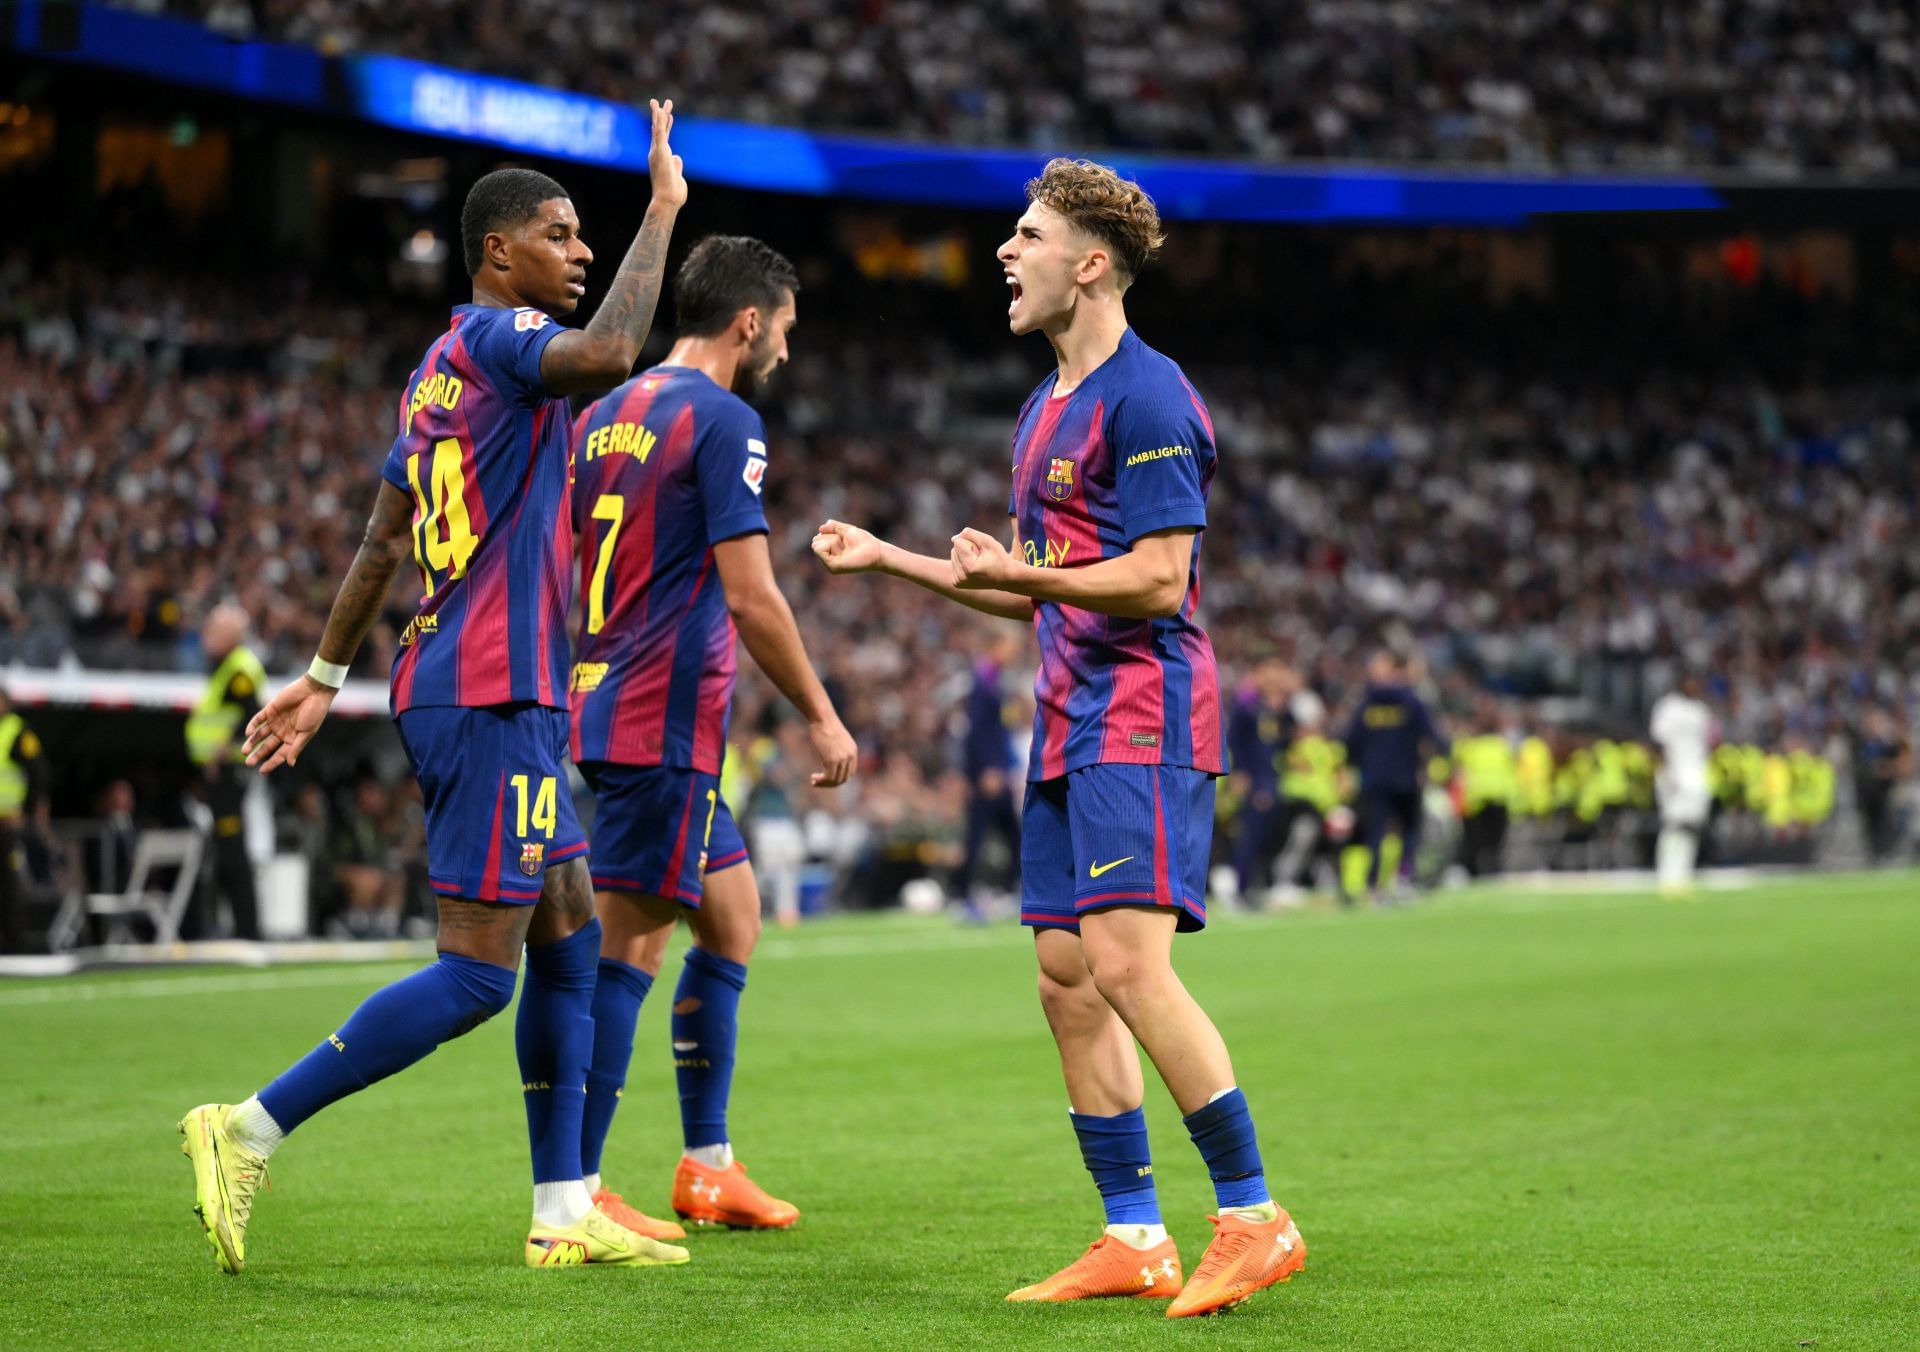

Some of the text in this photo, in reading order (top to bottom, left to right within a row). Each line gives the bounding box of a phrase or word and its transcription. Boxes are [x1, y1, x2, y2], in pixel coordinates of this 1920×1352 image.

[586, 422, 657, 464] FERRAN
[1126, 445, 1183, 467] AMBILIGHT
[407, 437, 479, 598] 14
[588, 494, 624, 634] 7
[511, 774, 557, 839] 14
